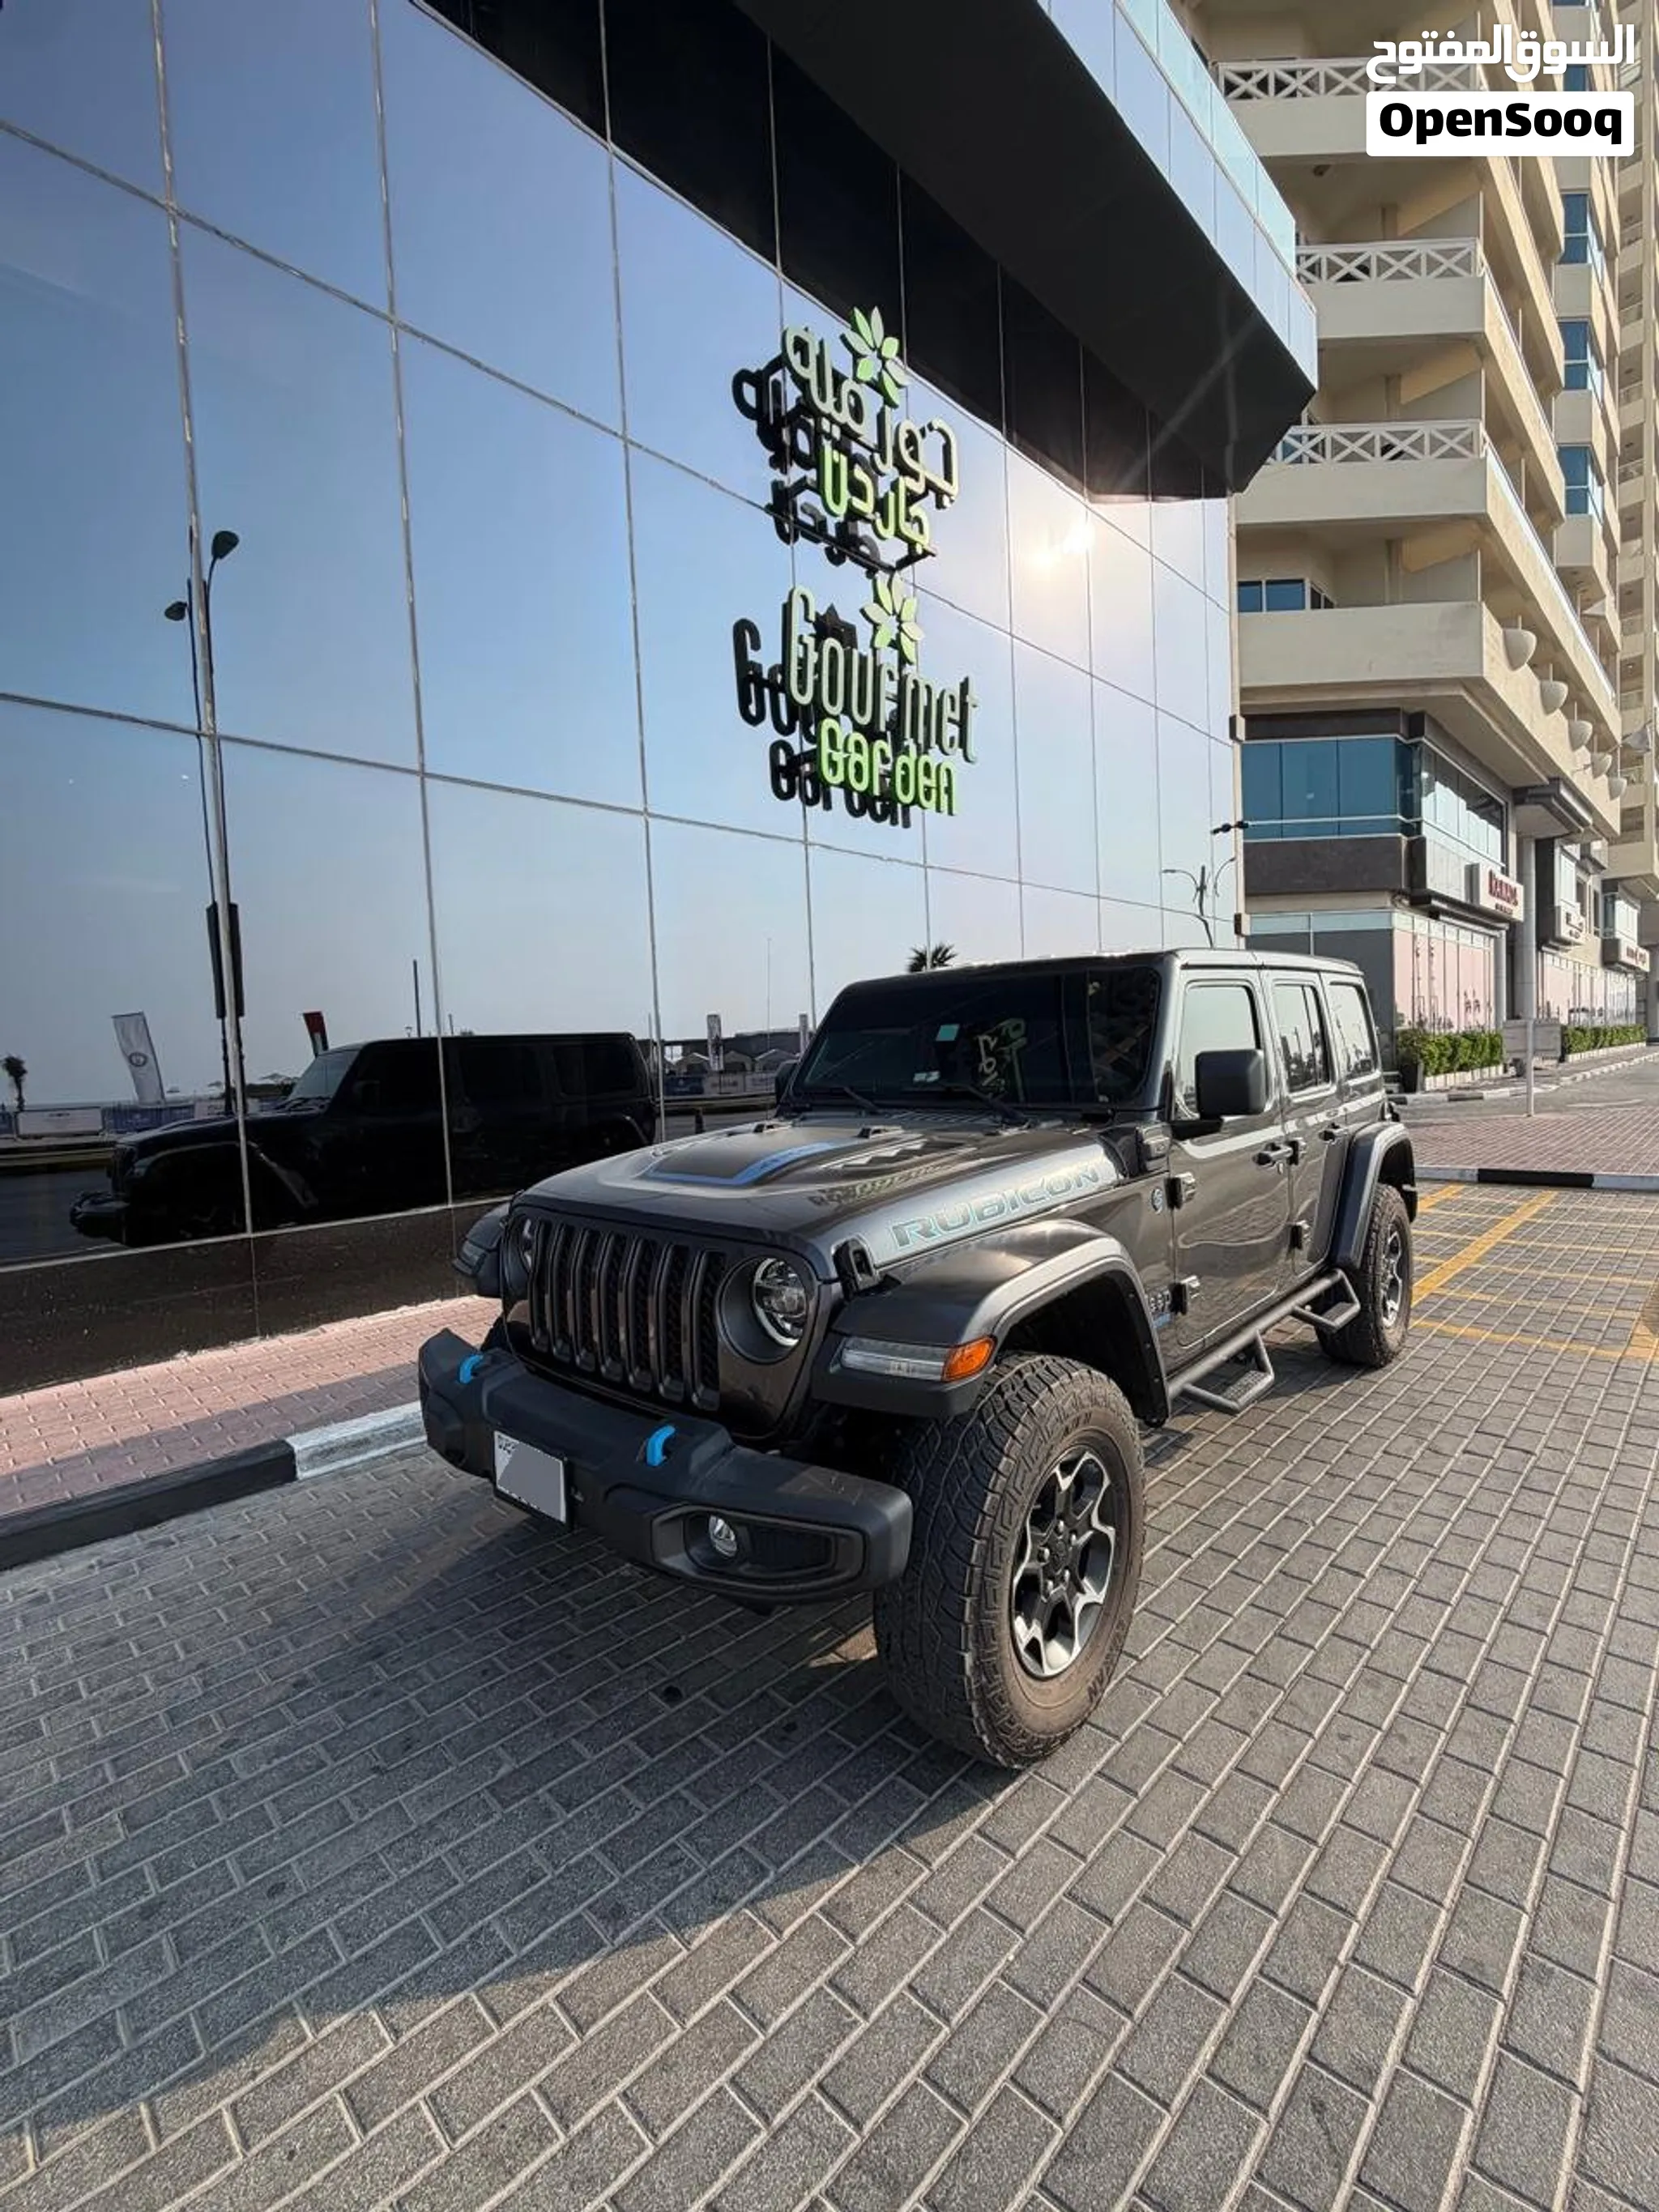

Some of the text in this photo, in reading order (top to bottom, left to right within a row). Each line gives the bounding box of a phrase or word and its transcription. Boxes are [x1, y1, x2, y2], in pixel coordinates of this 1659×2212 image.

[783, 584, 979, 764] Gourmet
[817, 718, 957, 816] Garden
[891, 1161, 1101, 1248] RUBICON
